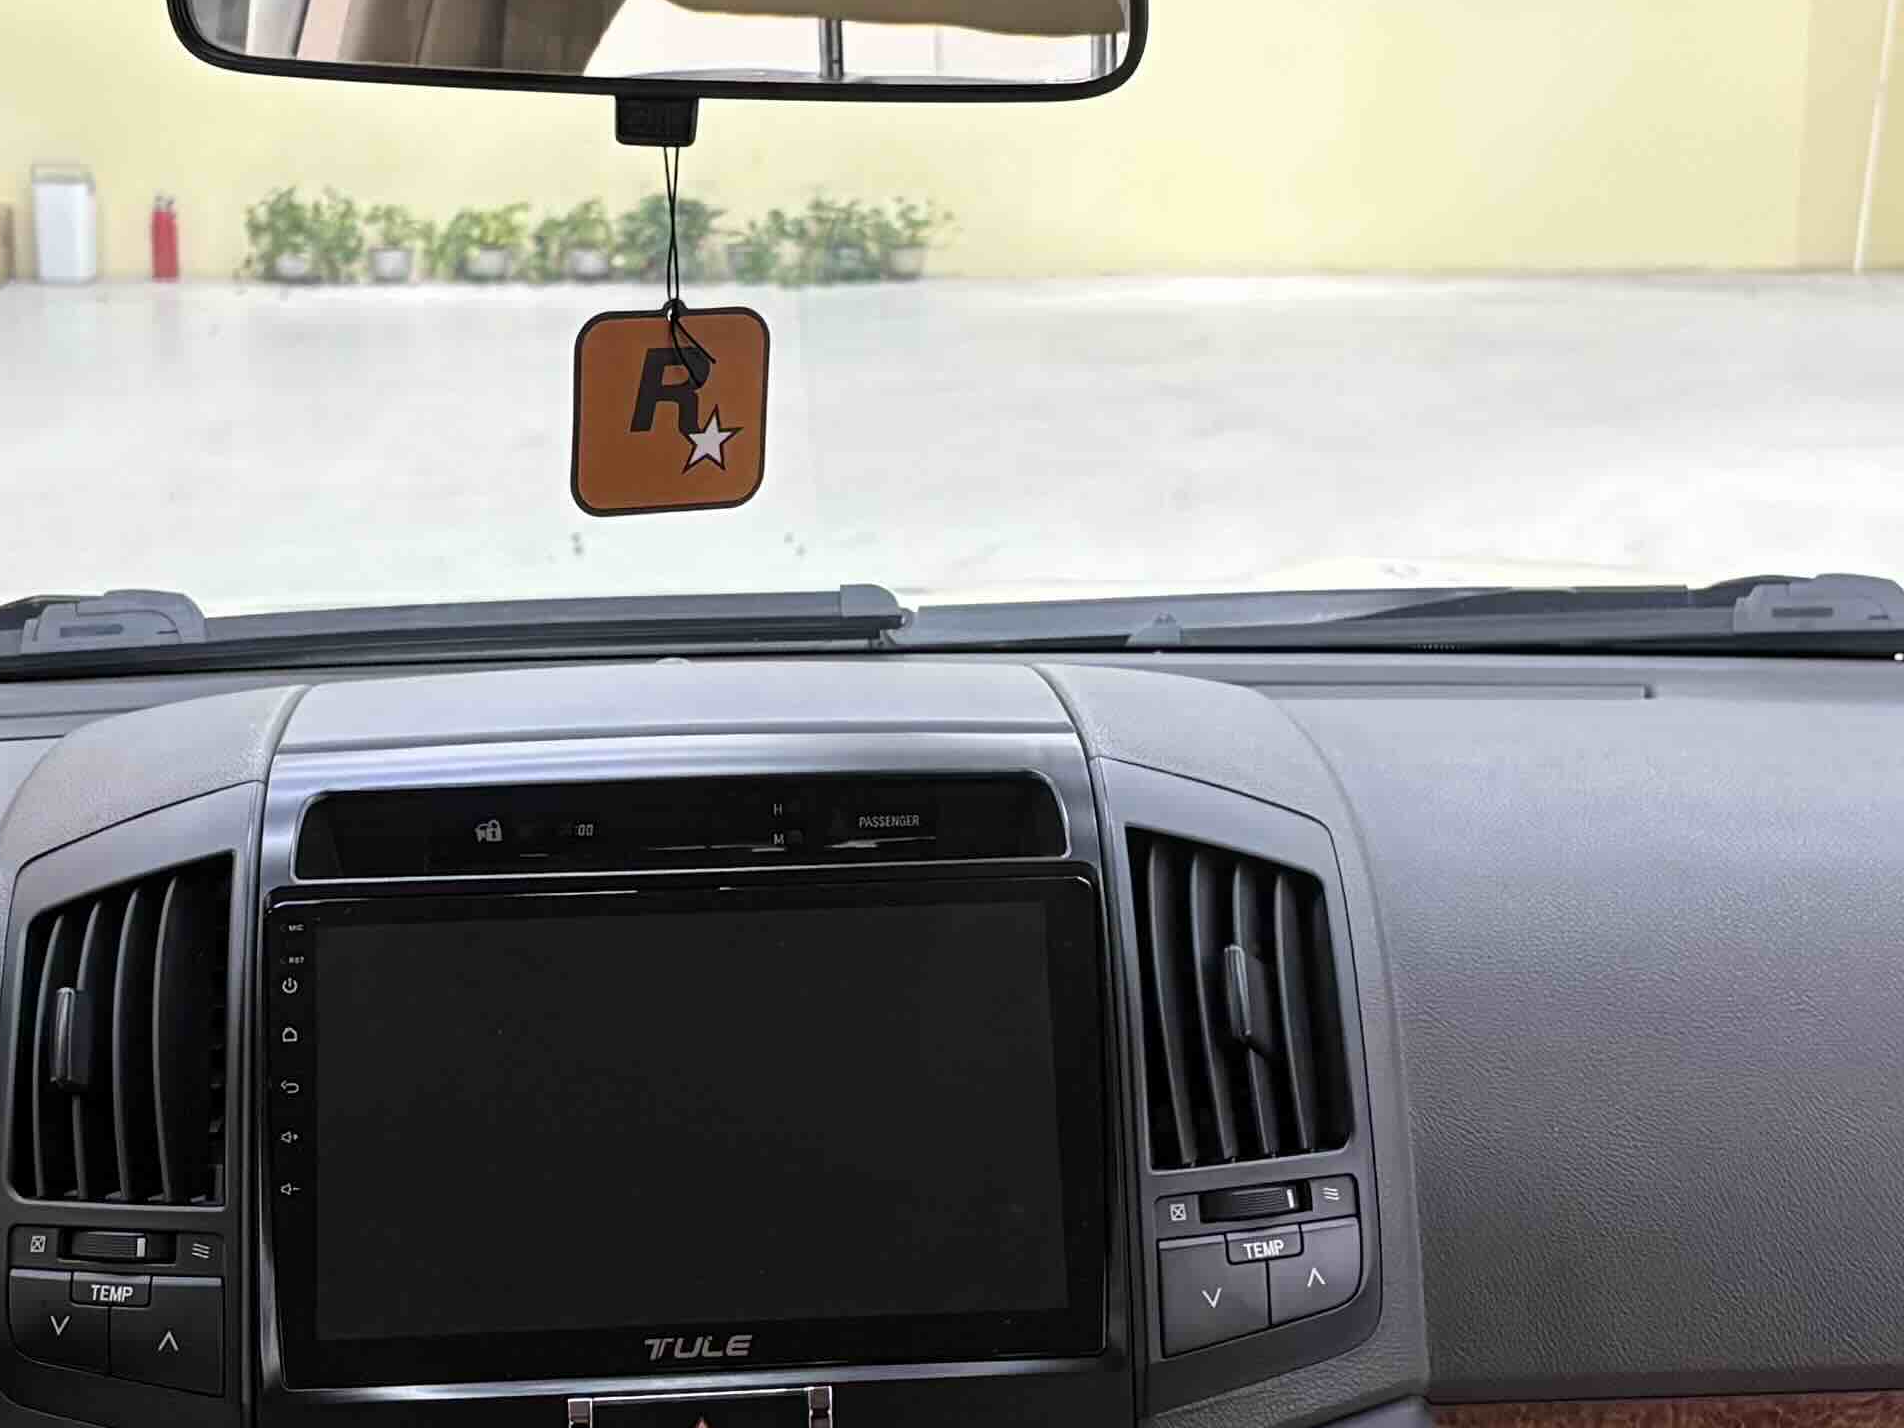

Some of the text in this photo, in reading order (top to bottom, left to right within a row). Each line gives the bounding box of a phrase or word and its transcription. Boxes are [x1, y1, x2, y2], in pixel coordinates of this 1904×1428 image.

[629, 347, 711, 433] R
[858, 814, 920, 829] PASSENGER
[1243, 1239, 1285, 1259] TEMP
[91, 1284, 134, 1302] TEMP
[645, 1334, 753, 1361] TULE
